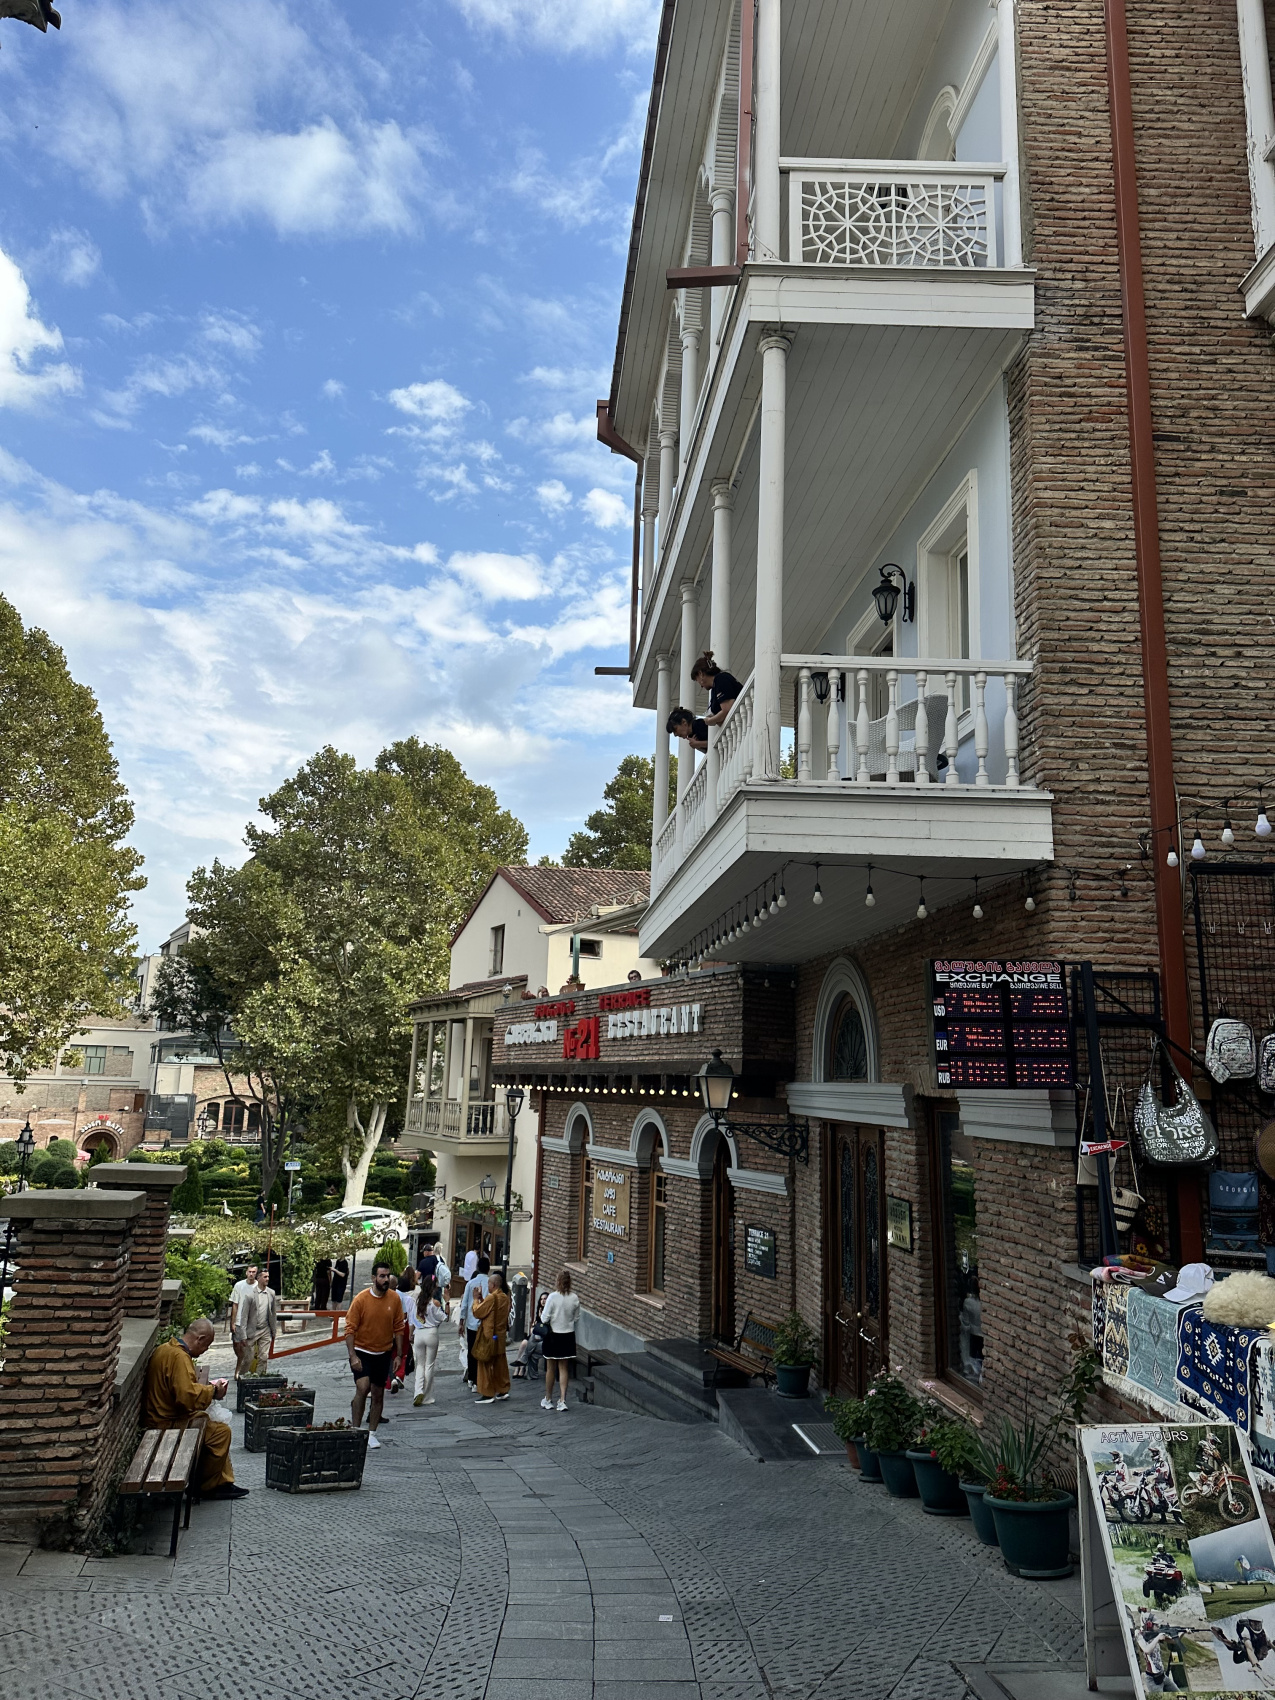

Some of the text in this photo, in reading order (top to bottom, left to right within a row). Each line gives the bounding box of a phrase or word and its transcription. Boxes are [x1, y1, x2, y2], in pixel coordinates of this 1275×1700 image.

[934, 961, 1062, 973] ვალუტის გაცვლა
[935, 973, 1062, 982] EXCHANGE
[598, 988, 652, 1010] TERRACE
[933, 1005, 946, 1017] USD
[607, 1003, 705, 1039] RESTAURANT
[936, 1039, 948, 1051] EUR
[938, 1072, 951, 1084] RUB
[1219, 1184, 1256, 1193] GEORGIA
[602, 1203, 616, 1217] CAFE
[593, 1217, 626, 1237] RESTAURANT
[1100, 1430, 1189, 1443] ACTIVE TOURS
